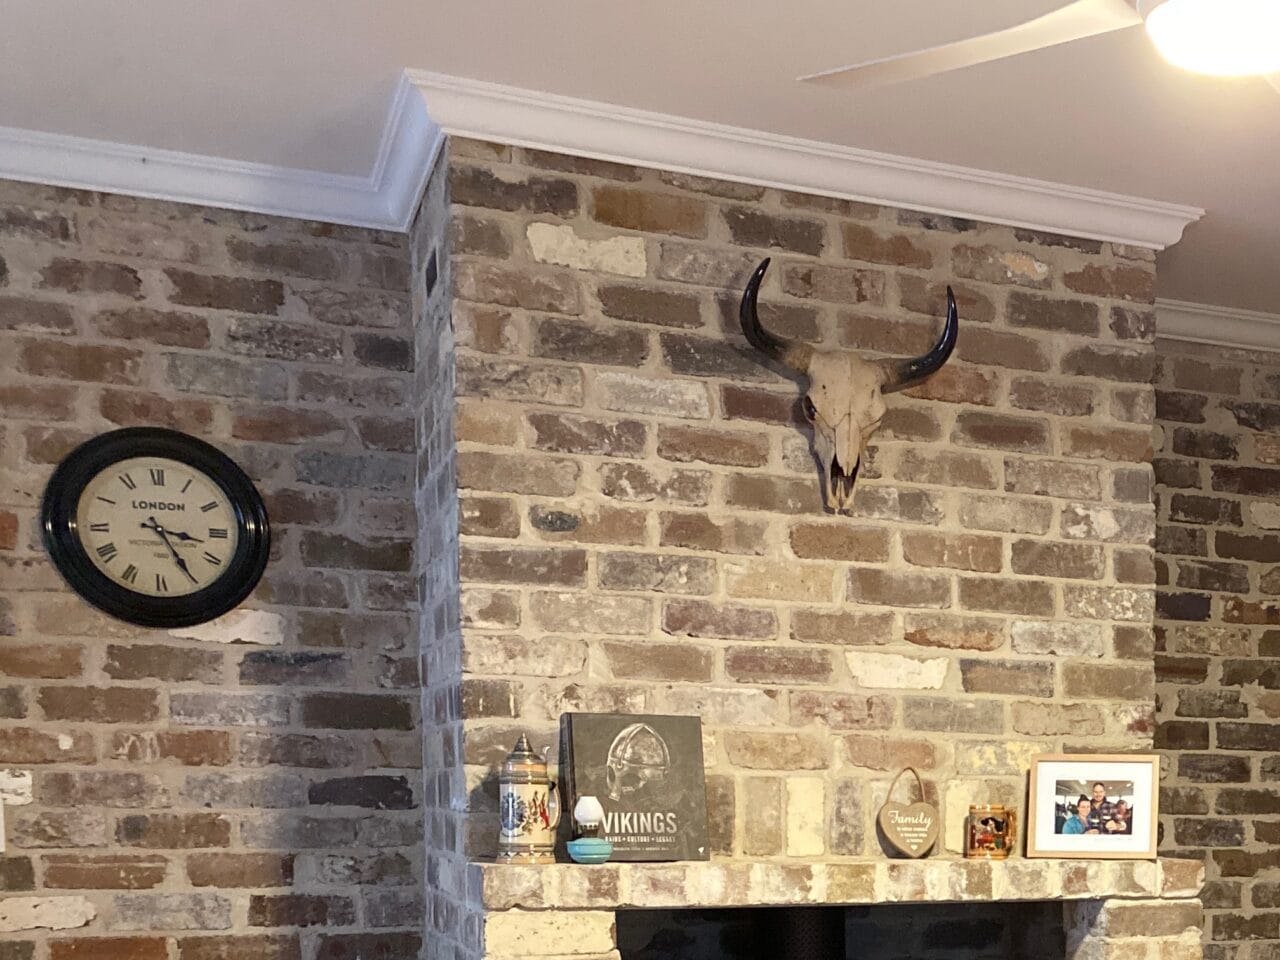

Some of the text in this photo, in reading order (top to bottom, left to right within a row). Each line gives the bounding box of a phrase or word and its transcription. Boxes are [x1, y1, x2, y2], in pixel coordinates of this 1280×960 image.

[132, 501, 185, 511] LONDON
[602, 812, 677, 833] VIKINGS
[887, 810, 932, 830] Family
